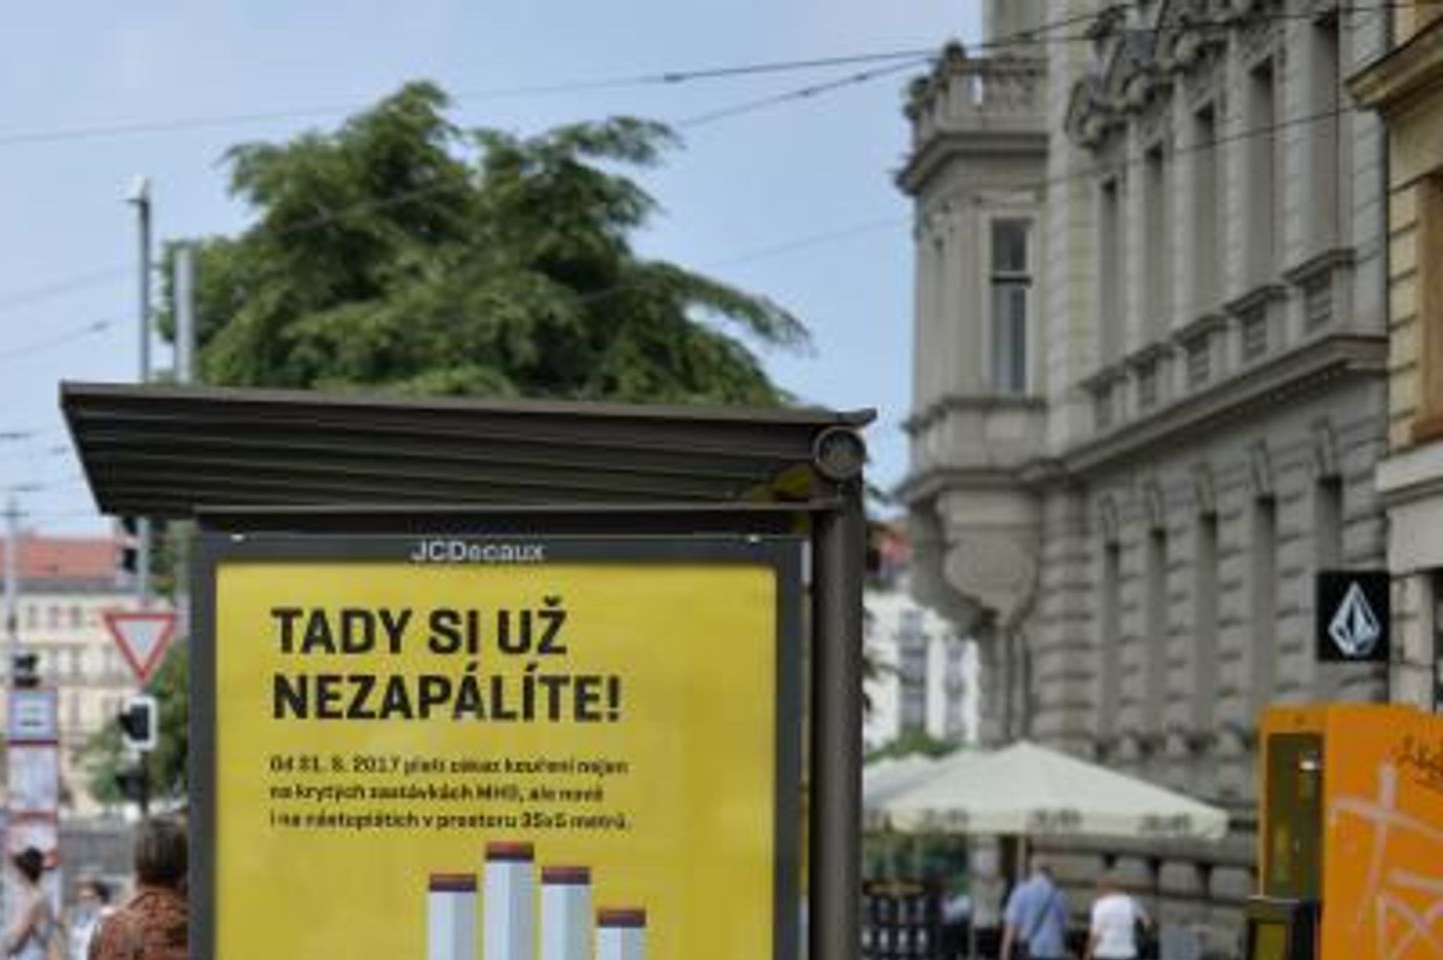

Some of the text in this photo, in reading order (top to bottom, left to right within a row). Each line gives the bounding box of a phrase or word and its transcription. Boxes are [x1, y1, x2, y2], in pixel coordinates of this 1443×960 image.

[411, 540, 545, 563] JCDecaux
[270, 597, 567, 655] TADY SI UŽ
[272, 662, 620, 722] NEZAPÁLÍTE!
[269, 755, 294, 773] Od
[353, 754, 400, 774] 2017
[576, 758, 629, 779] nejen
[295, 783, 365, 804] krytých
[369, 782, 473, 803] zastávkách
[476, 784, 524, 803] MHD,
[422, 814, 434, 828] v
[436, 812, 517, 831] prostoru
